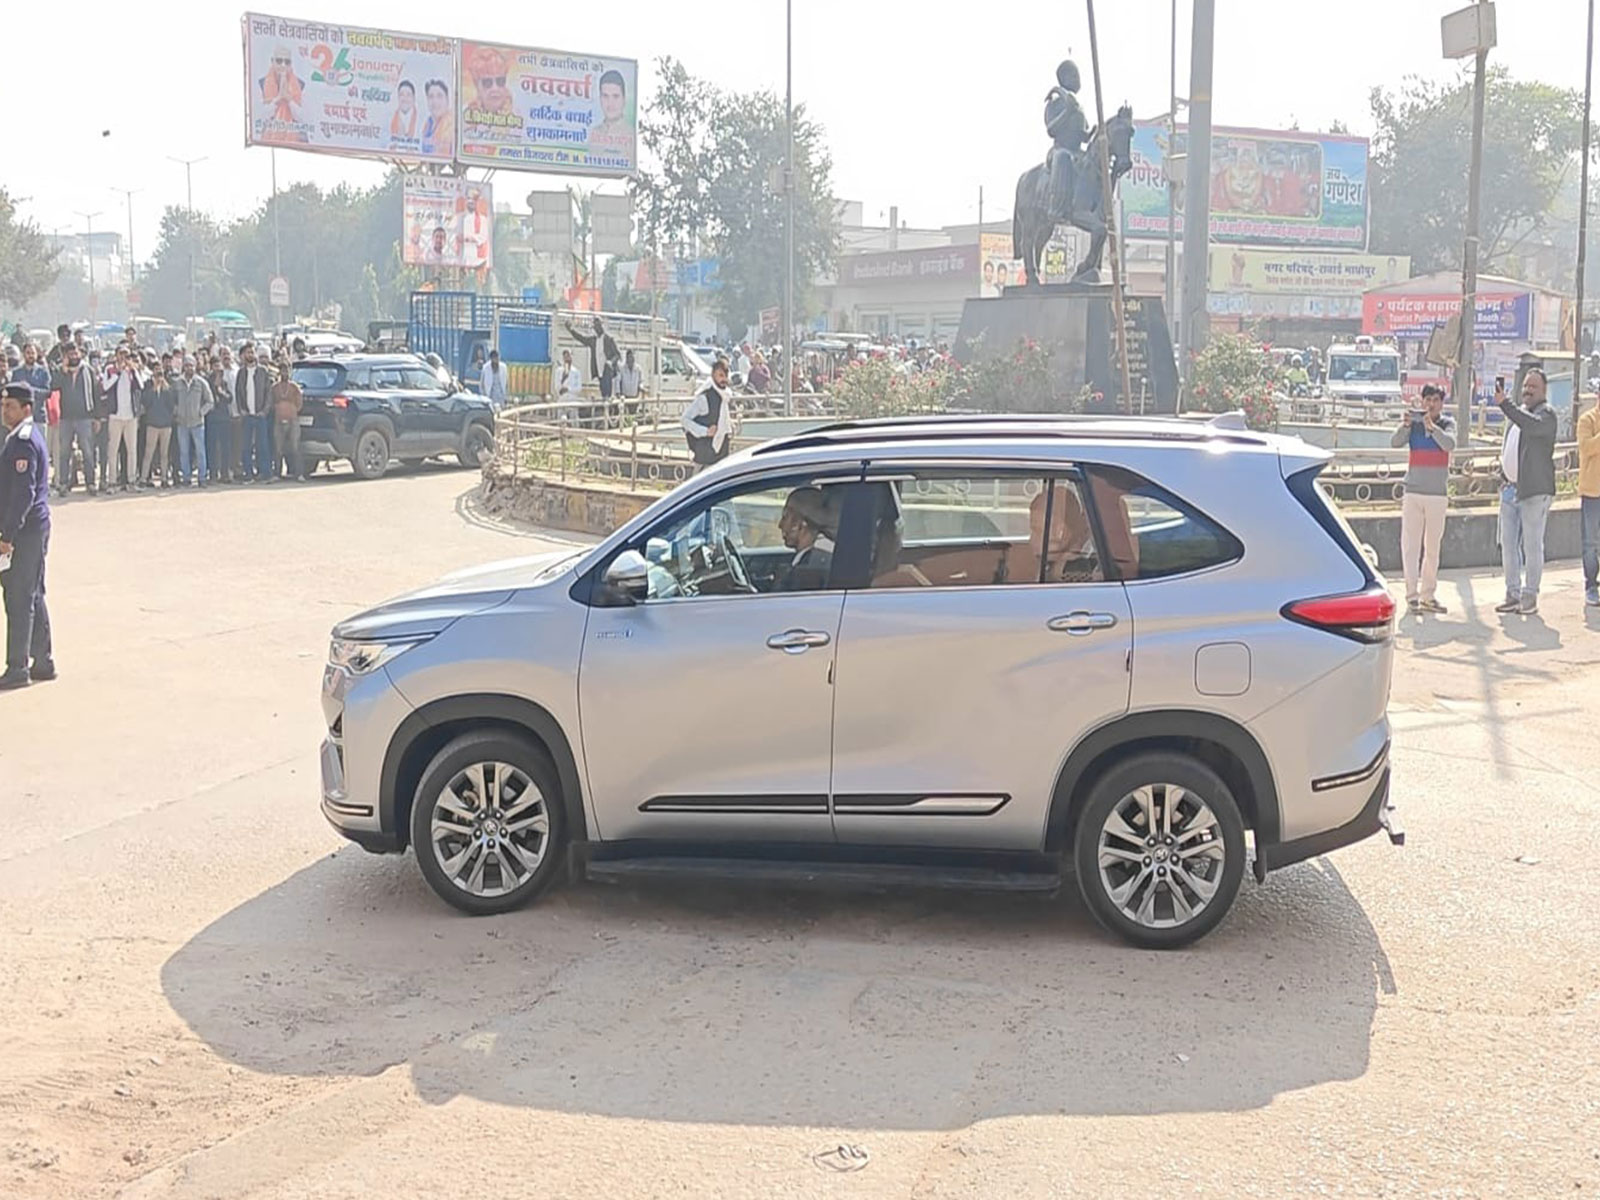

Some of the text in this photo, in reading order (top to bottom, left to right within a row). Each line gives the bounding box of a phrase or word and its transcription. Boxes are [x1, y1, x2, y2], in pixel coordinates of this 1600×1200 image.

[253, 19, 276, 37] सभी
[330, 27, 344, 45] को
[519, 53, 537, 66] सभी
[591, 60, 604, 74] को
[520, 74, 593, 99] नववर्ष
[529, 105, 562, 122] हार्दिक
[565, 110, 593, 127] बधाई
[1326, 168, 1341, 180] जय
[1326, 176, 1363, 203] गणेश
[1264, 261, 1284, 273] नगर
[1388, 298, 1425, 312] पर्यटक
[1478, 313, 1499, 323] Booth
